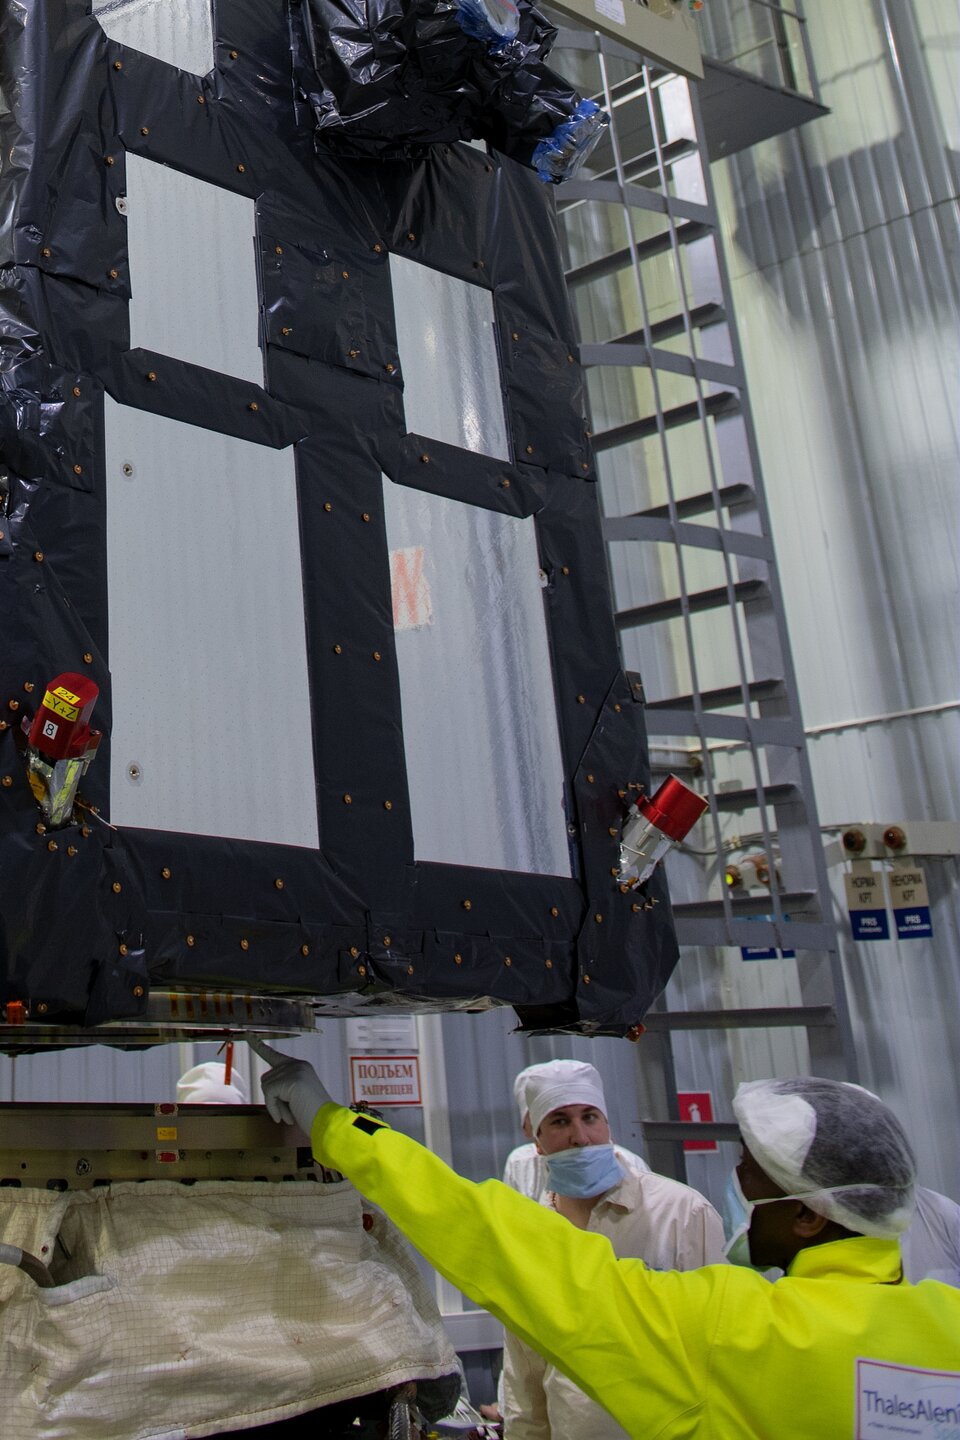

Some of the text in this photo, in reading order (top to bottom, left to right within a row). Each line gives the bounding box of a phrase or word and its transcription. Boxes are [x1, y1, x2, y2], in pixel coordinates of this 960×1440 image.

[57, 688, 75, 701] 24
[45, 723, 55, 736] 8
[358, 1064, 414, 1080] ПОДЪЕМ
[361, 1084, 414, 1096] ЗАПРЕЩЕН
